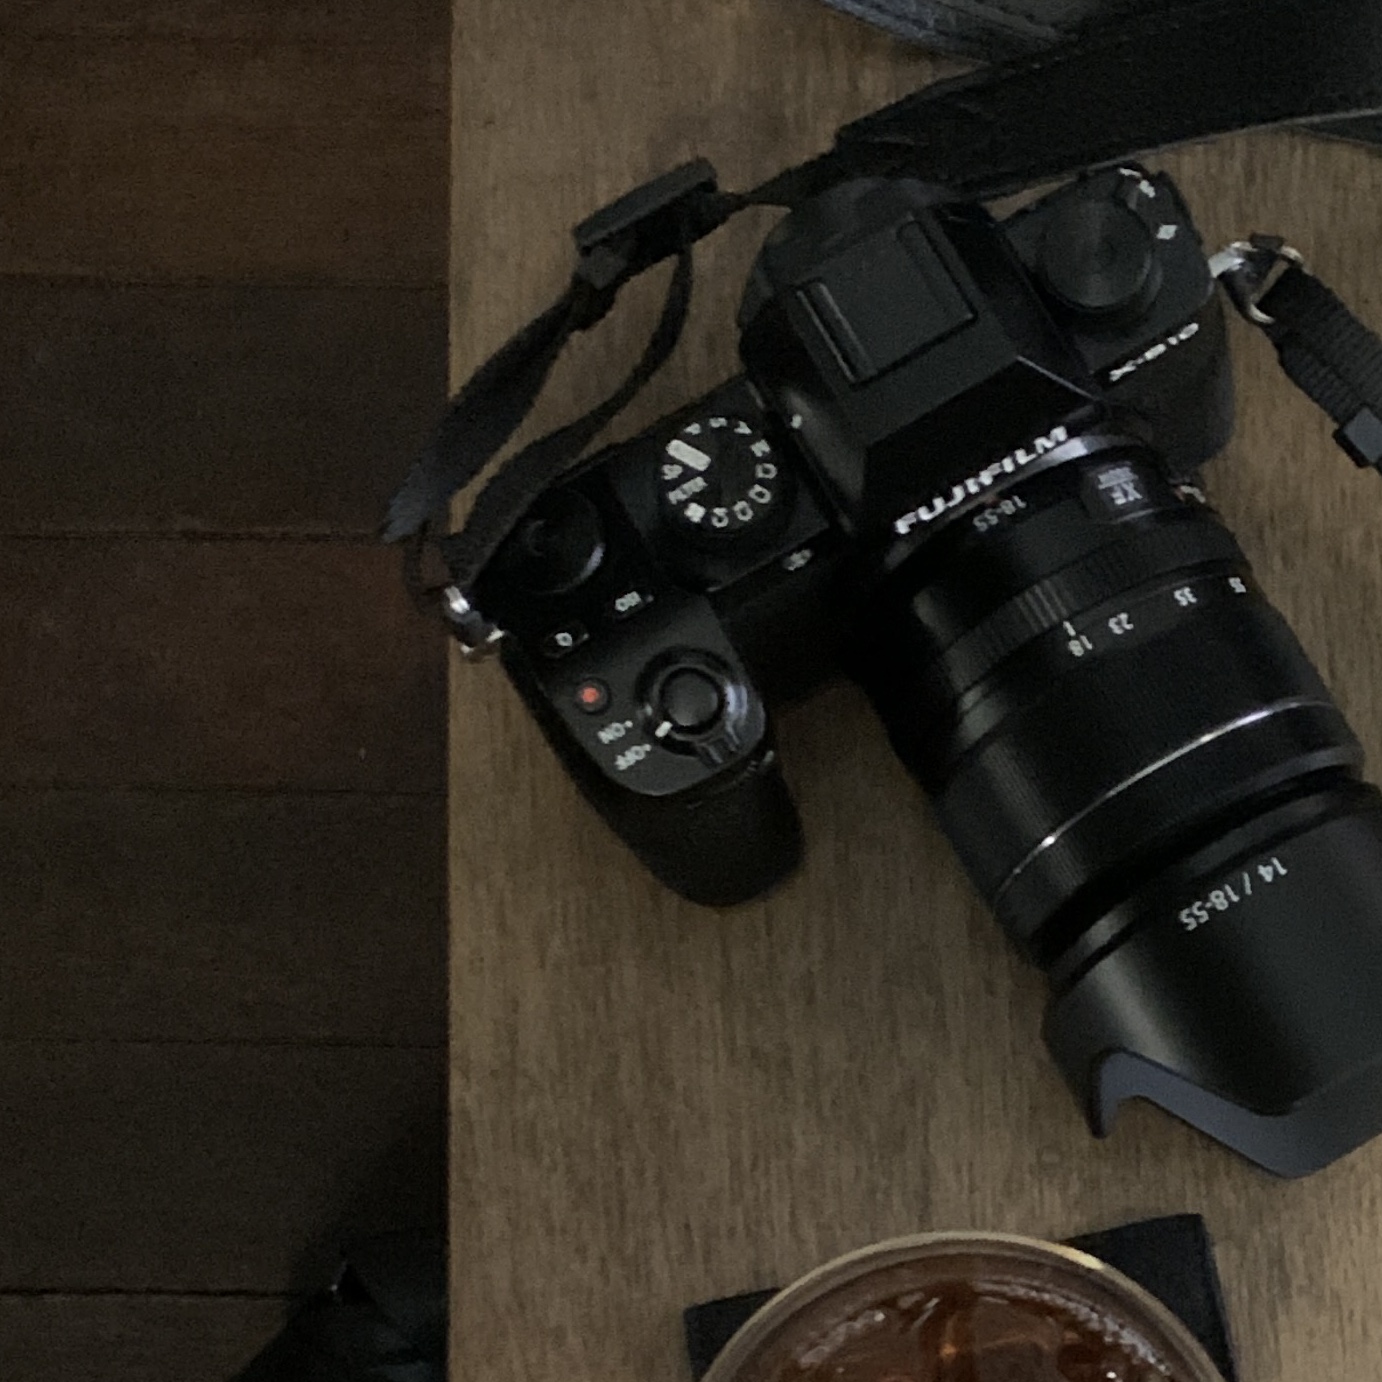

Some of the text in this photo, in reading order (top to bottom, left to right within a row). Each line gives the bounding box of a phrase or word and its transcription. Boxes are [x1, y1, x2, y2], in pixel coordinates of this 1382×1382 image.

[893, 425, 1069, 535] FUJIFILM
[972, 495, 1027, 533] 18-55
[1173, 586, 1198, 606] 35
[1107, 612, 1134, 635] 23
[1067, 634, 1093, 657] 18
[1256, 856, 1288, 883] 14
[1178, 883, 1240, 932] 18-55
